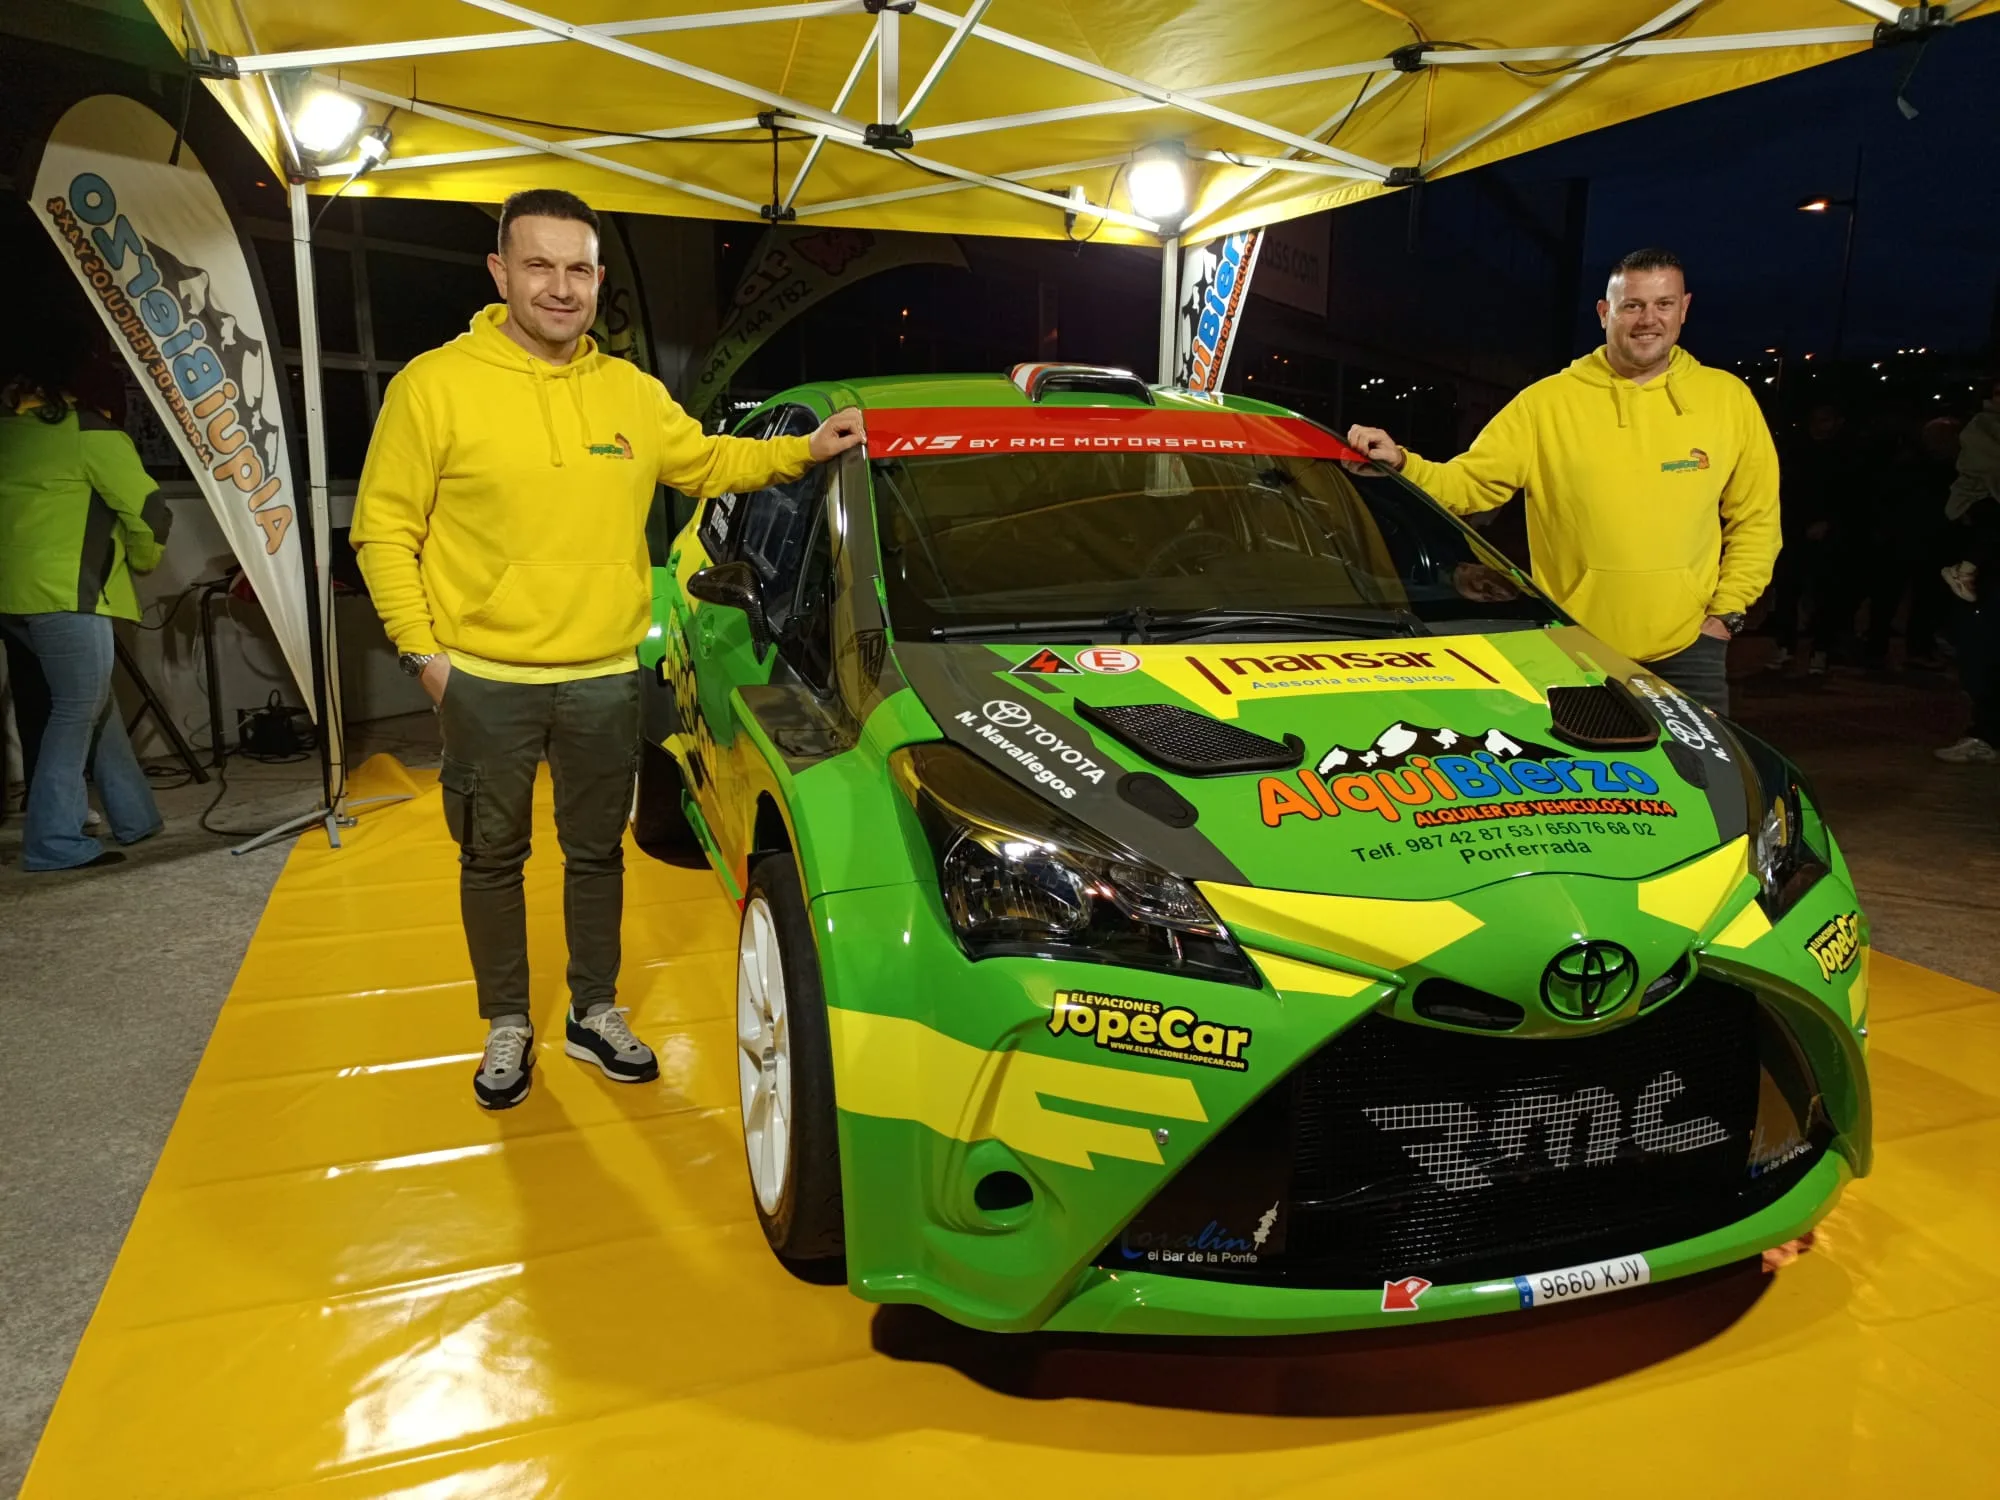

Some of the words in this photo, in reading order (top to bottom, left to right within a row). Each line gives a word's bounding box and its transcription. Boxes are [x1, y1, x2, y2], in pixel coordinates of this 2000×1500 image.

[770, 279, 814, 311] 782
[969, 438, 1000, 448] BY
[1010, 438, 1065, 447] RMC
[1074, 437, 1247, 449] MOTORSPORT
[1092, 651, 1126, 668] E
[1219, 651, 1436, 676] nansar
[1348, 675, 1371, 684] en
[1374, 673, 1456, 685] Seguros
[954, 710, 978, 727] N.
[976, 723, 1077, 799] Navaliegos
[1025, 724, 1105, 784] TOYOTA
[1258, 752, 1660, 827] AlquiBierzo
[1414, 806, 1502, 827] ALQUILER
[1506, 802, 1531, 817] DE
[1531, 799, 1629, 815] VEHICULOS
[1351, 842, 1401, 863] Telf.
[1405, 834, 1443, 853] 987
[1449, 830, 1476, 846] 42
[1481, 827, 1503, 842] 87
[1510, 824, 1534, 838] 53
[1546, 821, 1581, 836] 650
[1581, 821, 1605, 835] 76
[1606, 821, 1630, 835] 68
[1633, 822, 1656, 836] 02
[1460, 839, 1592, 865] Ponferrada
[1071, 993, 1160, 1014] ELEVACIONES
[1048, 992, 1249, 1058] JopeCar
[1147, 1250, 1159, 1261] el
[1162, 1250, 1184, 1262] Bar
[1187, 1251, 1204, 1262] de
[1206, 1251, 1218, 1263] la
[1221, 1252, 1258, 1263] Ponfe
[1539, 1269, 1596, 1299] 9660
